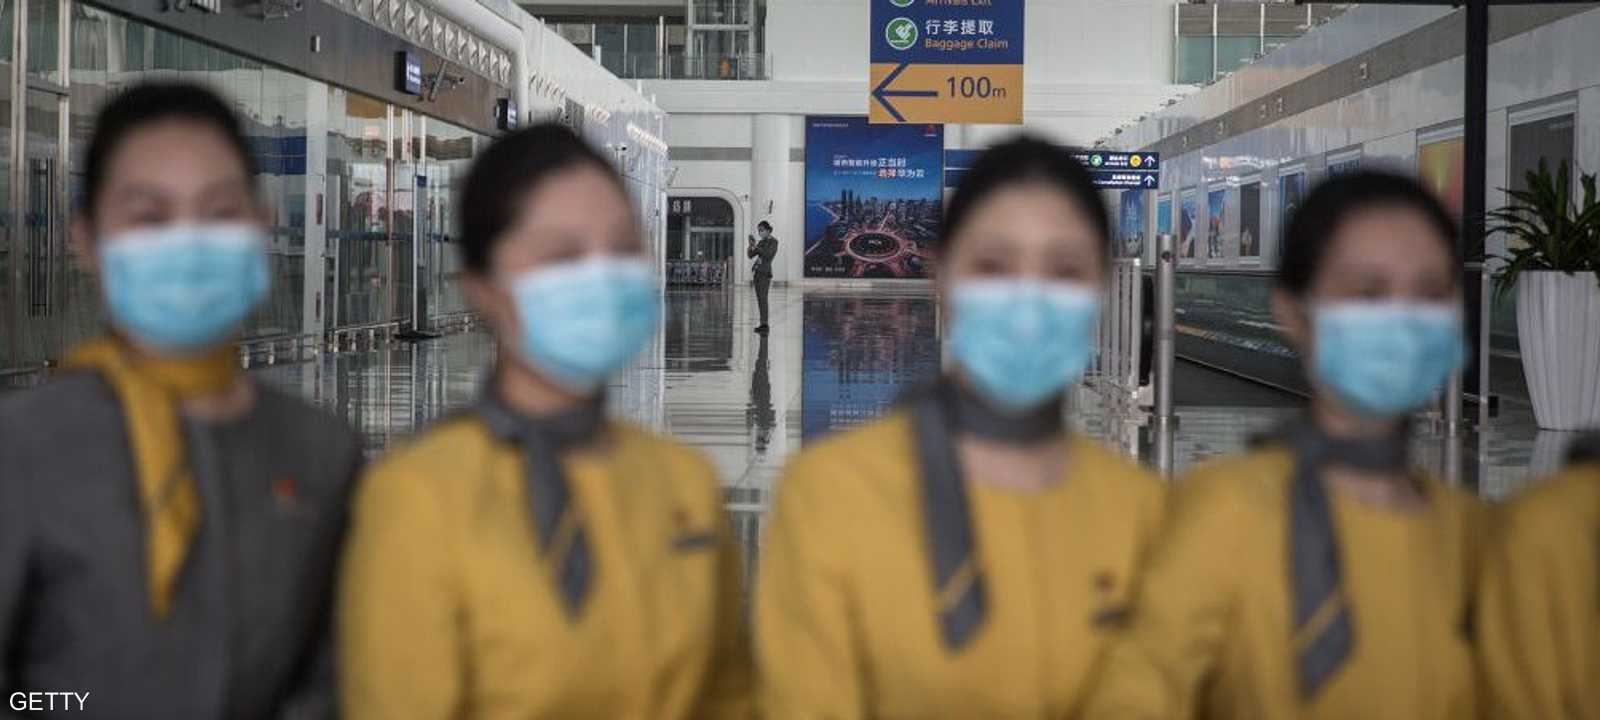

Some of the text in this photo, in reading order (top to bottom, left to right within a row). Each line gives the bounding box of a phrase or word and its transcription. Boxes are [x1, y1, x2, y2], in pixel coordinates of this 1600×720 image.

[925, 19, 994, 35] 行李提取
[925, 38, 1008, 50] Baggage Claim
[946, 76, 1006, 98] 100m
